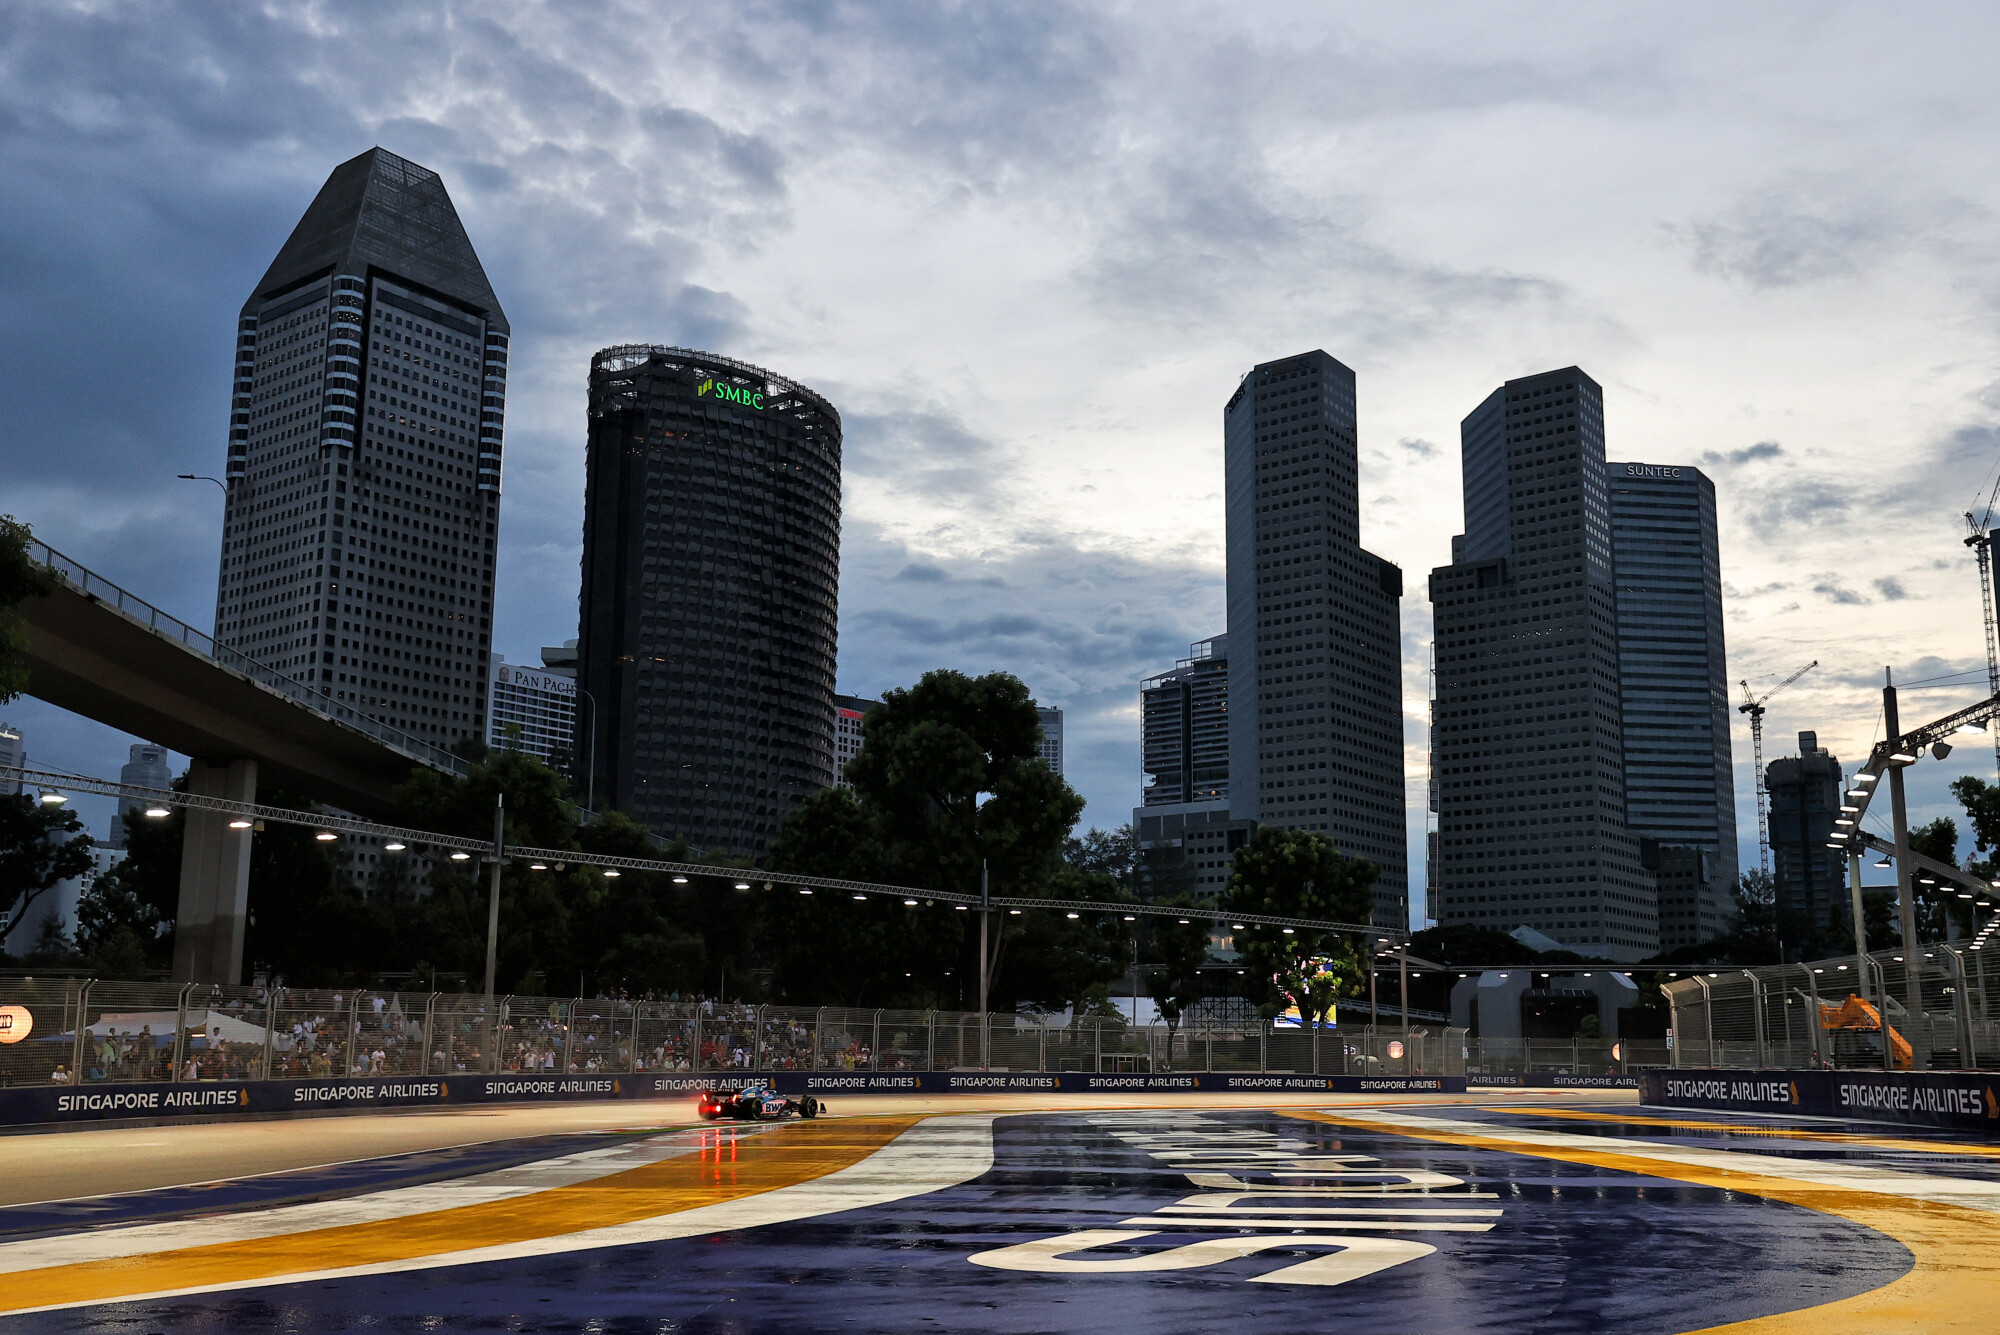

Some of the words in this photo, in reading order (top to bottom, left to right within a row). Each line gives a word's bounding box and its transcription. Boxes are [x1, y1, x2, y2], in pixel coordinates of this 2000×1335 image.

[715, 382, 764, 410] SMBC
[1627, 465, 1680, 478] SUNTEC
[515, 671, 539, 687] PAN
[486, 1082, 556, 1094] SINGAPORE
[559, 1081, 612, 1093] AIRLINES
[655, 1079, 717, 1091] SINGAPORE
[720, 1079, 768, 1089] AIRLINES
[808, 1078, 866, 1088] SINGAPORE
[869, 1078, 914, 1087] AIRLINES
[951, 1078, 1006, 1087] SINGAPORE
[1009, 1078, 1053, 1087] AIRLINES
[1090, 1079, 1145, 1087] SINGAPORE
[1148, 1078, 1192, 1087] AIRLINES
[1229, 1079, 1283, 1087] SINGAPORE
[1285, 1079, 1327, 1088] AIRLINES
[1361, 1081, 1407, 1089] SINGAPORE
[1409, 1081, 1438, 1089] AIRLINES
[295, 1086, 375, 1102] SINGAPORE
[379, 1084, 439, 1098] AIRLINES
[1668, 1081, 1728, 1099] SINGAPORE
[1731, 1082, 1789, 1102] AIRLINES
[58, 1094, 159, 1111] SINGAPORE
[164, 1091, 237, 1107] AIRLINES
[1840, 1085, 1909, 1110] SINGAPORE
[1913, 1088, 1982, 1114] AIRLINES
[967, 1129, 1505, 1286] SINGAPORE
